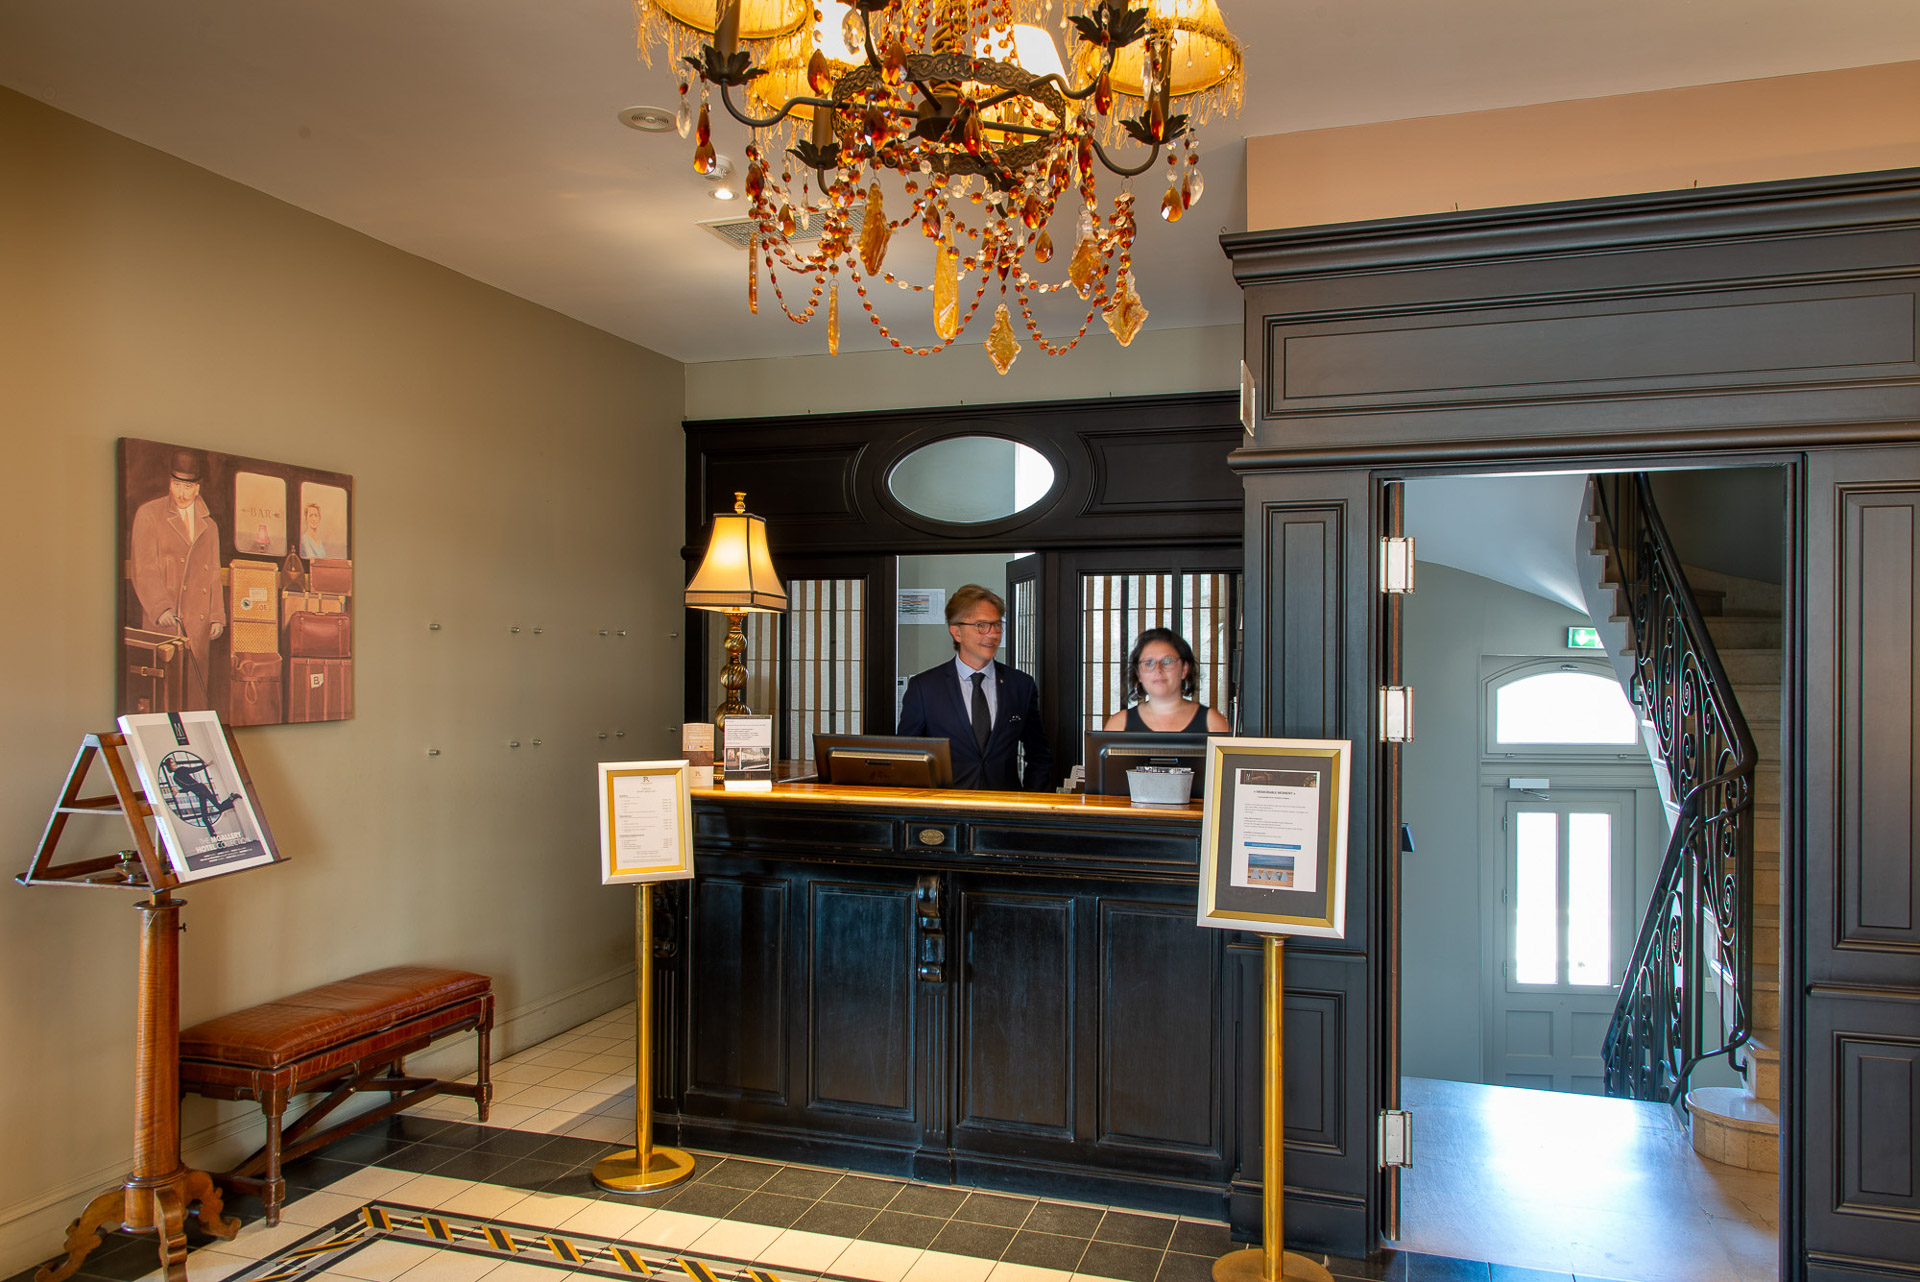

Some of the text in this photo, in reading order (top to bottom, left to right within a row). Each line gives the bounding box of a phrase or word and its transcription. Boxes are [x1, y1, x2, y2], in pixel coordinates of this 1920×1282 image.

[250, 506, 272, 519] BAR
[313, 676, 320, 685] B
[210, 831, 241, 843] MGALLERY
[195, 843, 217, 853] HOTEL
